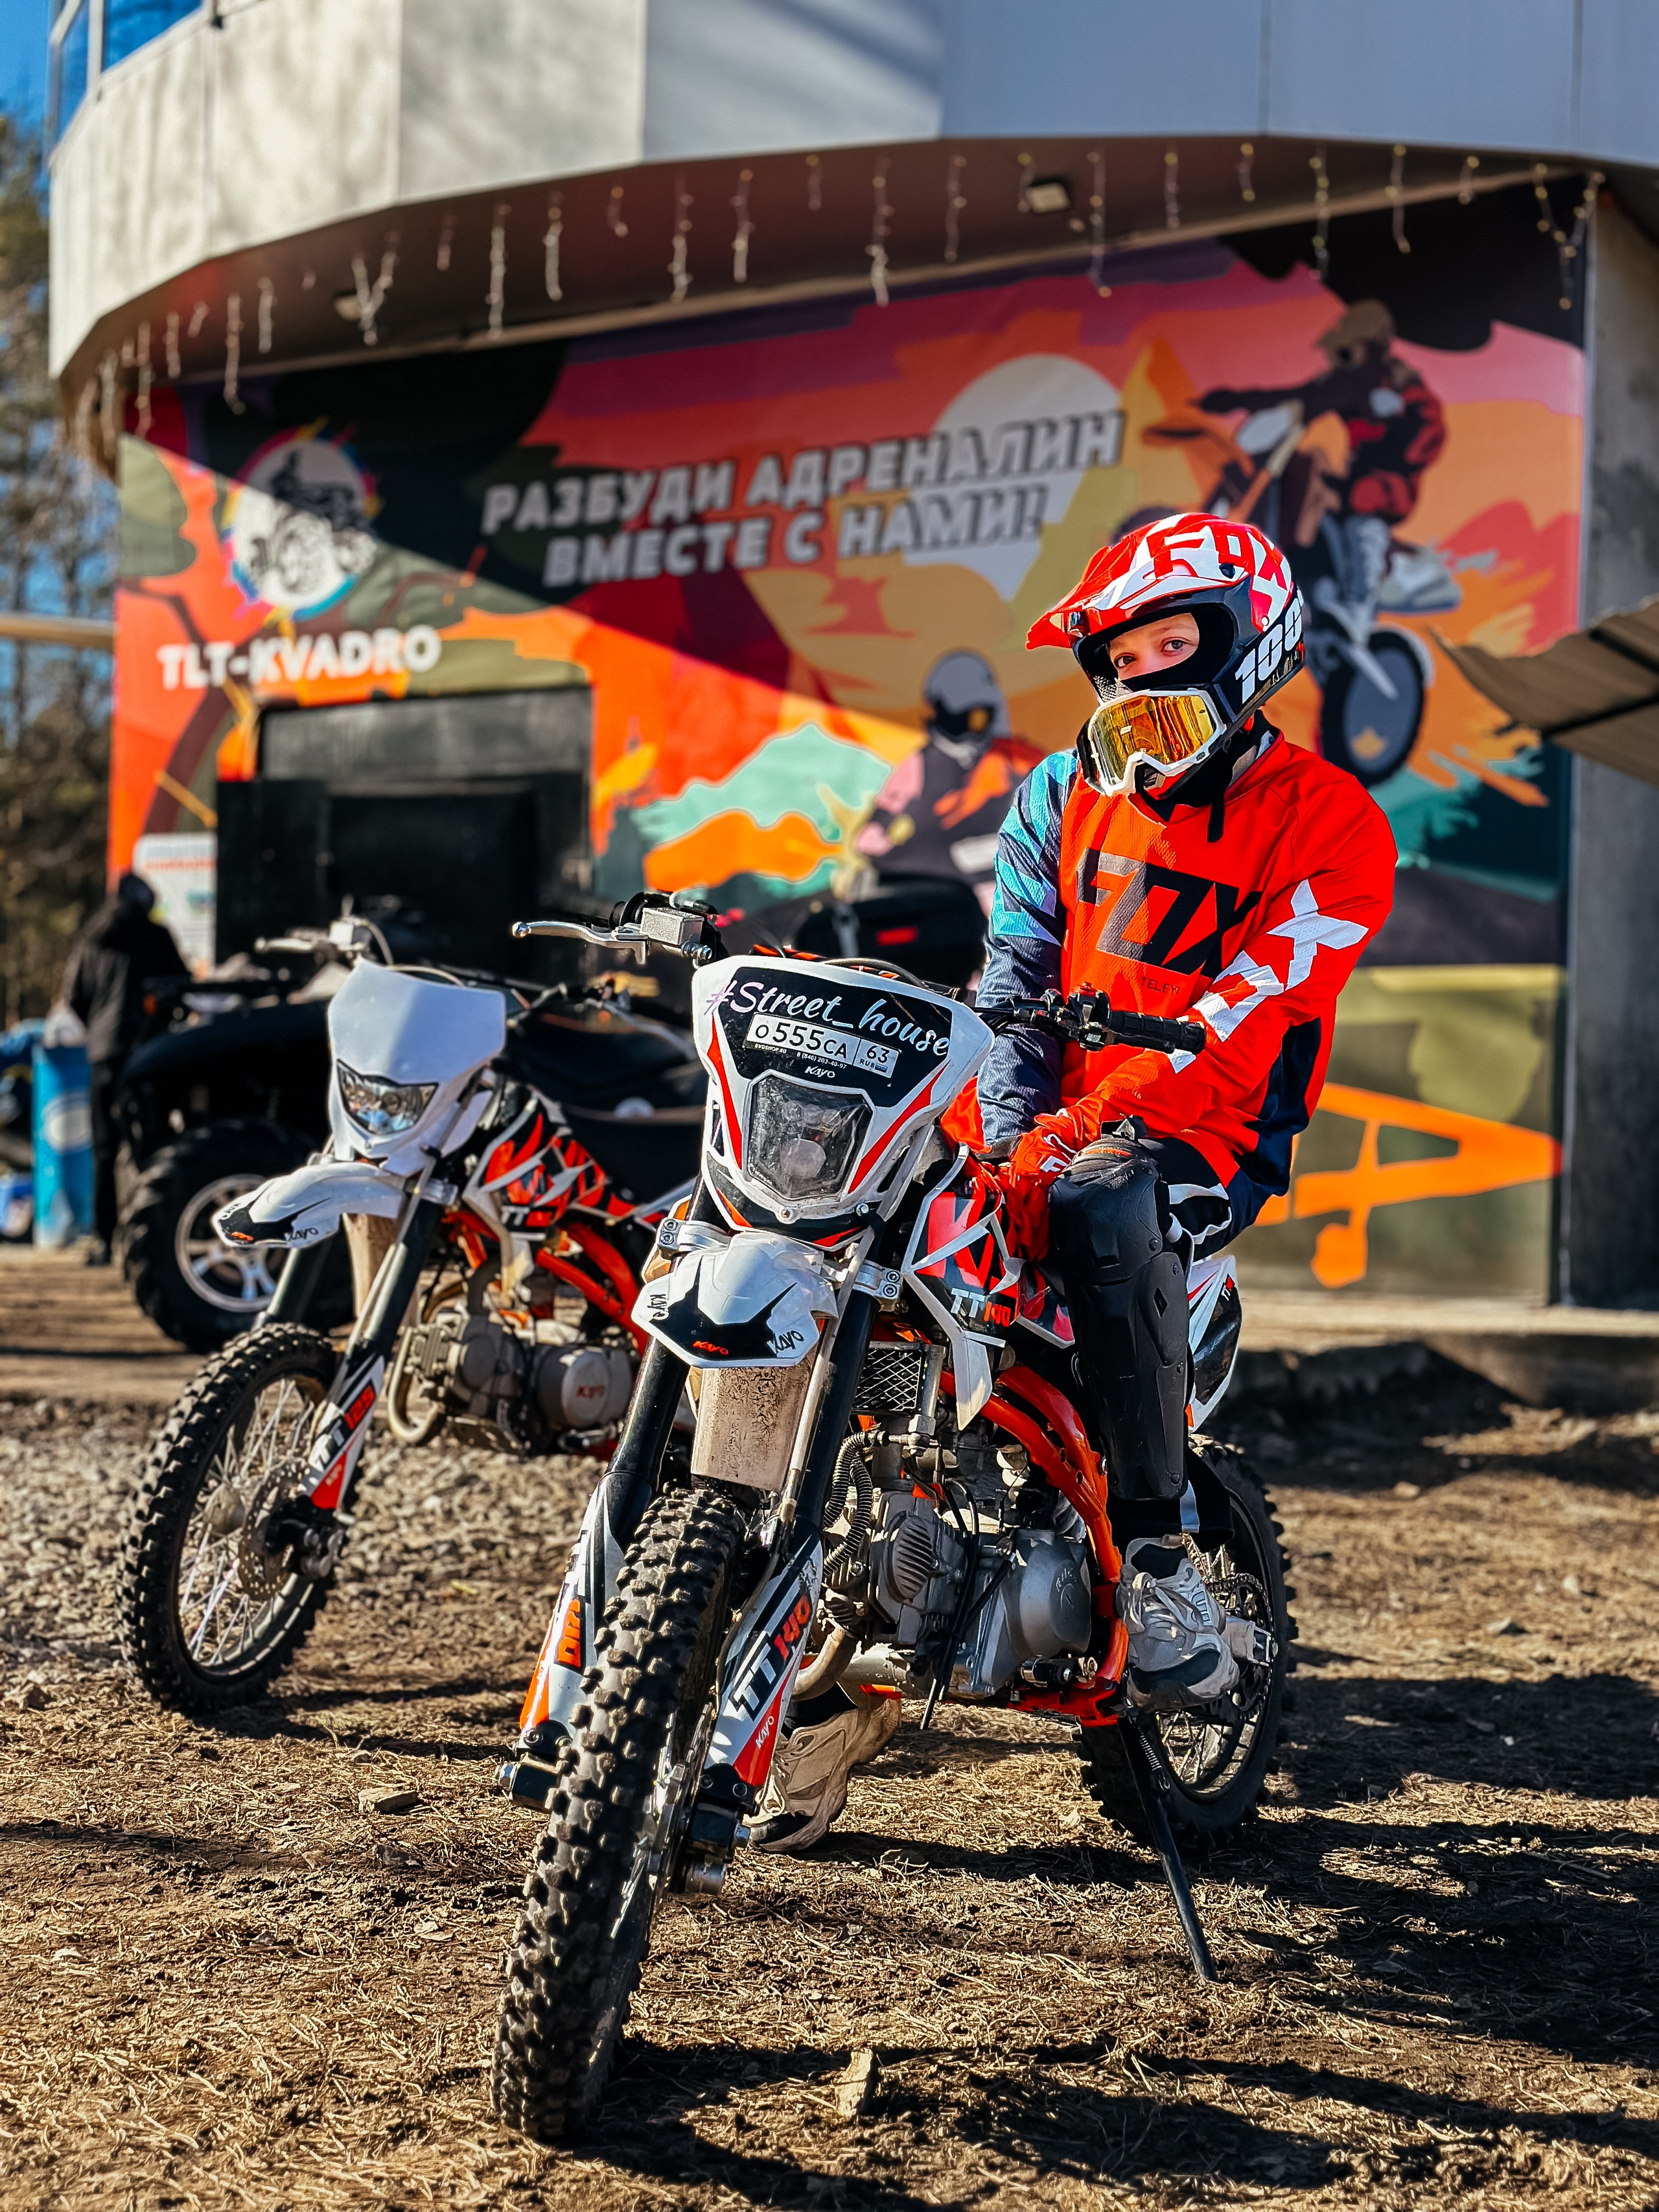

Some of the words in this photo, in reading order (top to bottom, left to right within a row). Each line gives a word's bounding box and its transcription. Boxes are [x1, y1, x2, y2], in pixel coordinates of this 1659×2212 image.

[481, 460, 735, 536] РАЗБУДИ
[744, 409, 1126, 508] АДРЕНАЛИН
[542, 518, 771, 588] ВМЕСТЕ
[785, 513, 822, 563] С
[156, 624, 443, 691] TLT-KVADRO
[1235, 589, 1304, 704] 100
[802, 1052, 817, 1062] (846)
[866, 1045, 890, 1064] 63
[804, 1066, 836, 1078] KAYO
[766, 1329, 805, 1355] KAYO
[755, 1715, 775, 1749] KAYO
